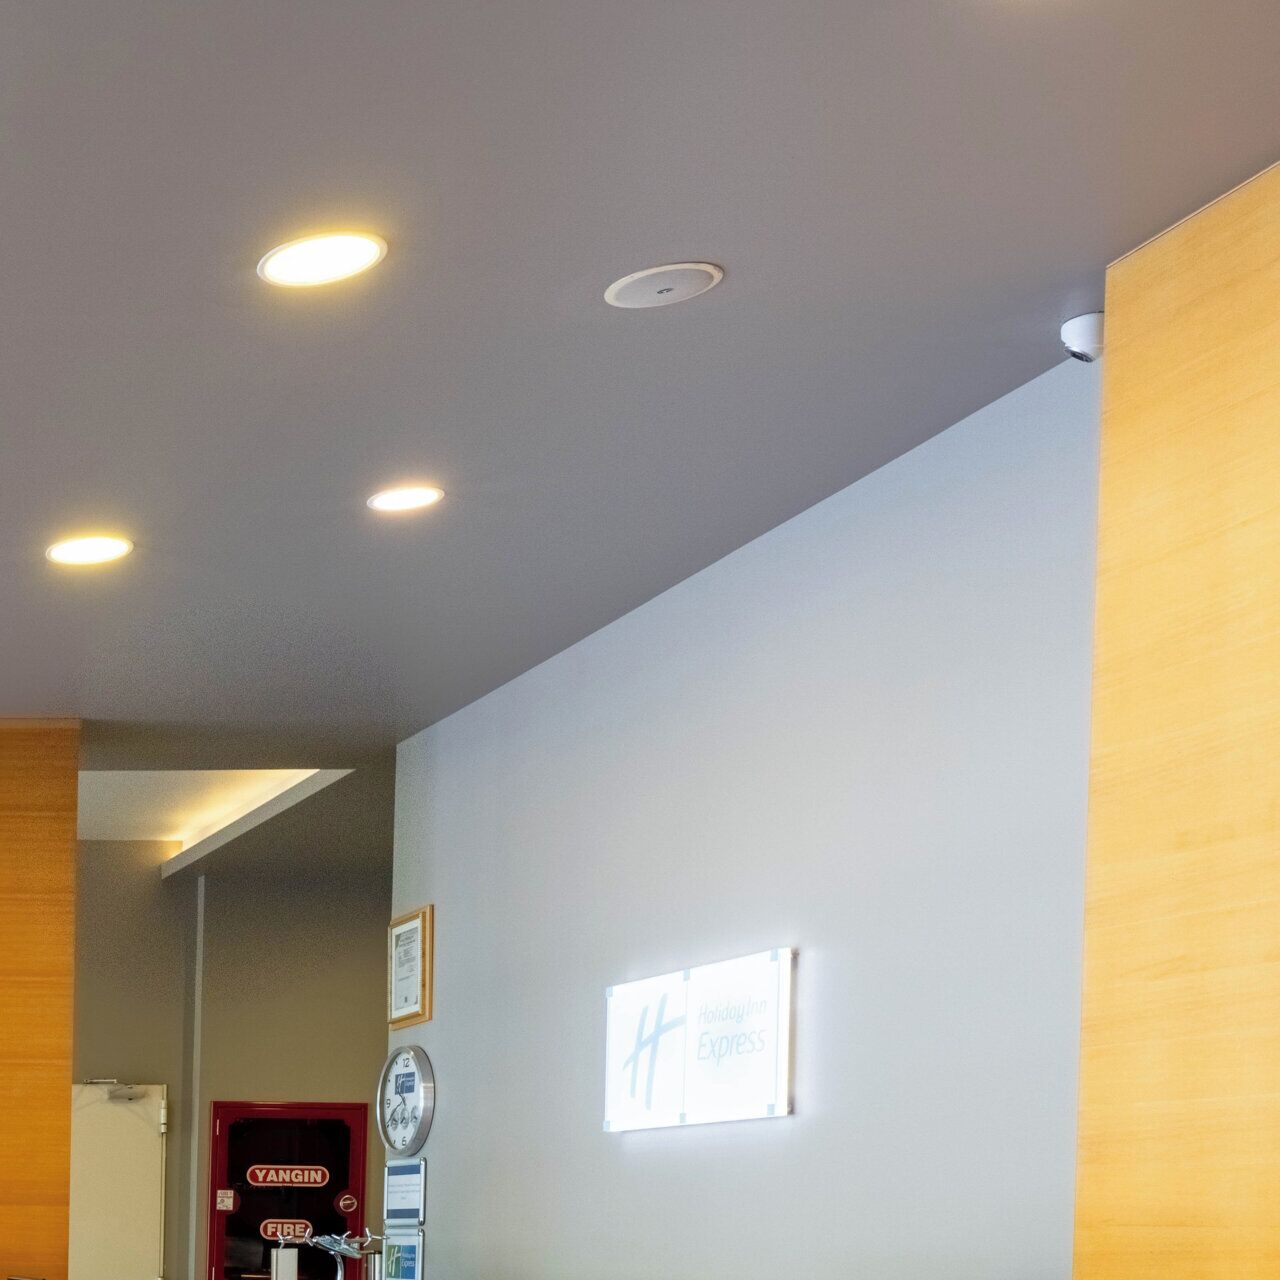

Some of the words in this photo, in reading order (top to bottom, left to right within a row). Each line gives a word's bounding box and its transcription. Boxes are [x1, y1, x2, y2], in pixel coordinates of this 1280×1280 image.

[697, 998, 744, 1025] Holiday
[745, 994, 768, 1018] Inn
[697, 1029, 769, 1067] Express
[402, 1058, 410, 1068] 12
[386, 1098, 391, 1108] 9
[401, 1136, 407, 1146] 6
[254, 1169, 322, 1183] YANGIN
[267, 1223, 306, 1237] FIRE
